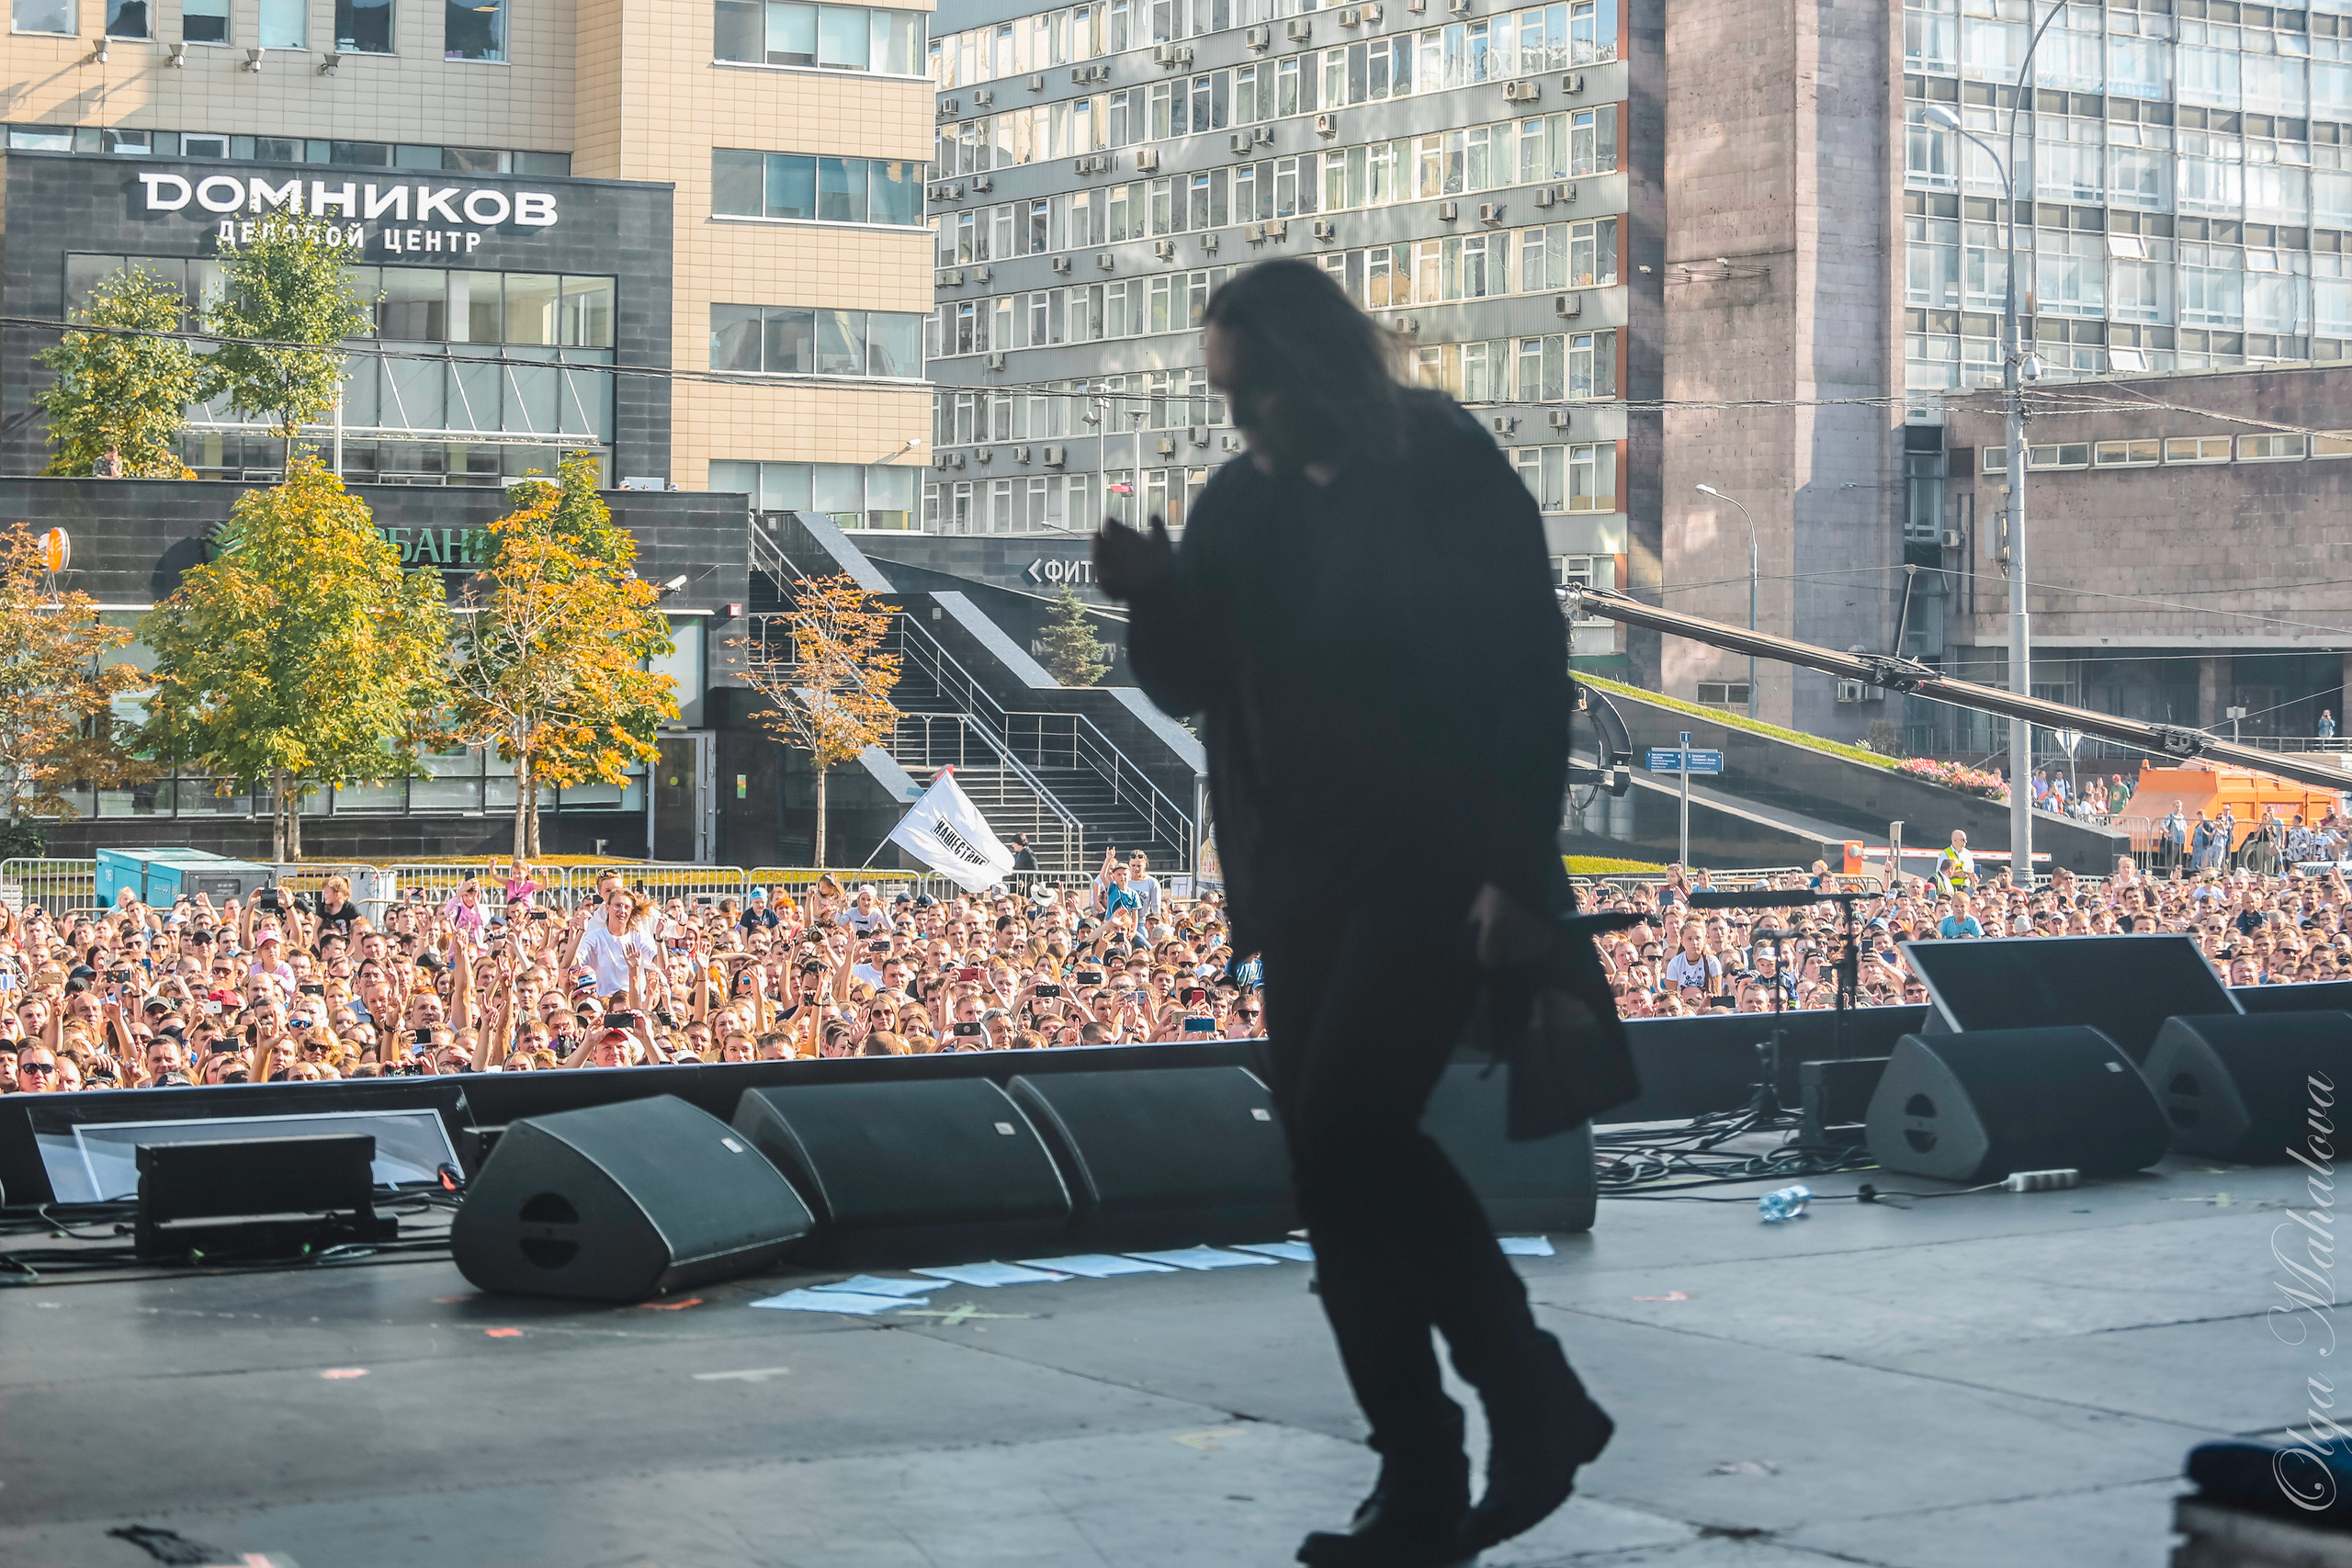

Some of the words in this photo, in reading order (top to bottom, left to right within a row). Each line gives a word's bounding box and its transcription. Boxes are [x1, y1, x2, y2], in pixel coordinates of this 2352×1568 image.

[384, 229, 481, 254] ЦЕНТР
[1044, 558, 1098, 583] ФИТ
[933, 820, 986, 865] НАШЕСТВИЕ
